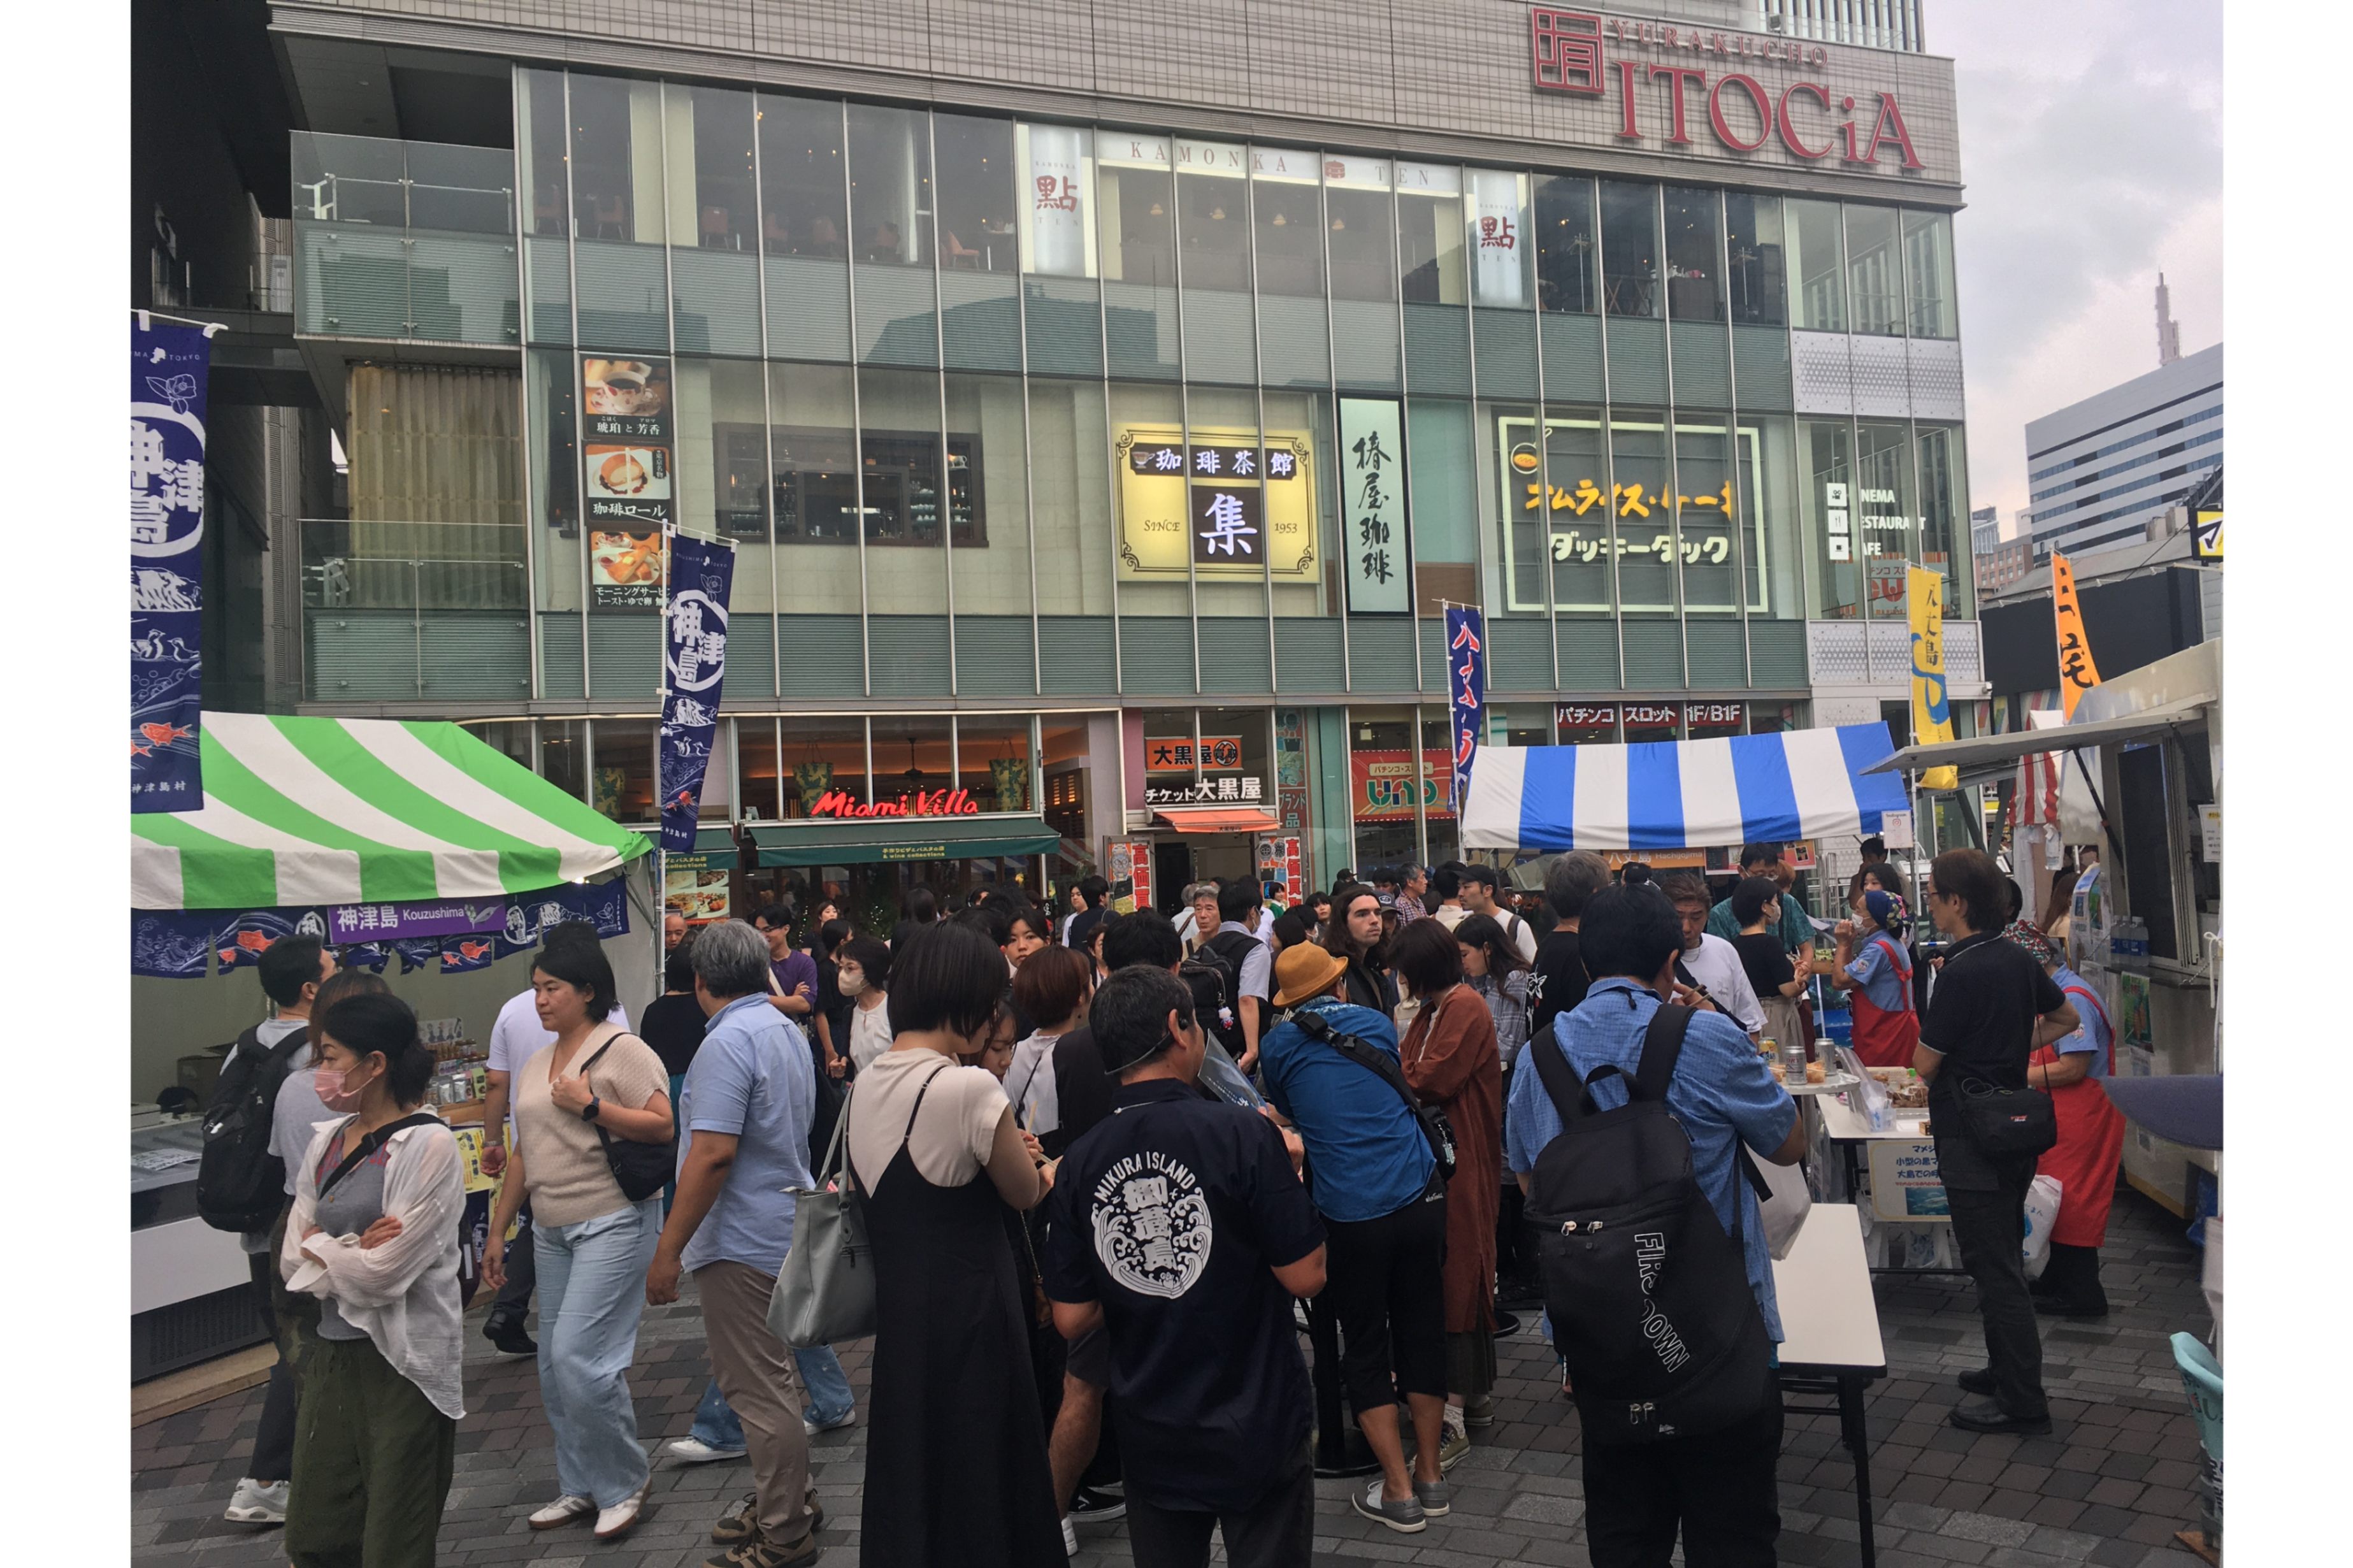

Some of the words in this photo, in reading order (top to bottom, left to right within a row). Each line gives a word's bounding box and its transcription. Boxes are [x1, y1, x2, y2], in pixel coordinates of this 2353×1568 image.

[1611, 18, 1829, 67] YURAKUCHO
[1612, 59, 1927, 171] ITOCiA
[1130, 141, 1287, 173] KAMONKA
[1374, 165, 1430, 186] TEN
[1036, 175, 1078, 213] 點
[1037, 217, 1079, 227] TEN
[1480, 215, 1515, 250] 點
[1155, 448, 1295, 476] 珈琲茶館
[593, 501, 667, 517] 珈琲ロール
[1352, 431, 1393, 584] 椿屋珈琲
[1860, 489, 1896, 503] NEMA
[1144, 519, 1181, 532] SINCE
[1274, 522, 1298, 534] 1953
[1199, 493, 1258, 556] 集
[1861, 515, 1927, 531] ESTAURAT
[1550, 530, 1729, 564] ダッキーダック
[1863, 542, 1882, 556] AFE
[1558, 706, 1615, 724] パチンコ
[1625, 706, 1676, 723] スロット
[1687, 704, 1741, 722] 1F/B1F
[1153, 745, 1212, 765] 大黒屋
[810, 791, 909, 818] Miami
[917, 788, 979, 815] Villa
[1286, 813, 1300, 828] 品
[1608, 851, 1651, 864] 八丈島
[1655, 851, 1703, 860] Hachijojima
[337, 904, 398, 932] 神津島
[403, 906, 464, 921] Kouzushima
[1093, 1153, 1143, 1203] MIKURA
[1146, 1151, 1196, 1190] ISLAND
